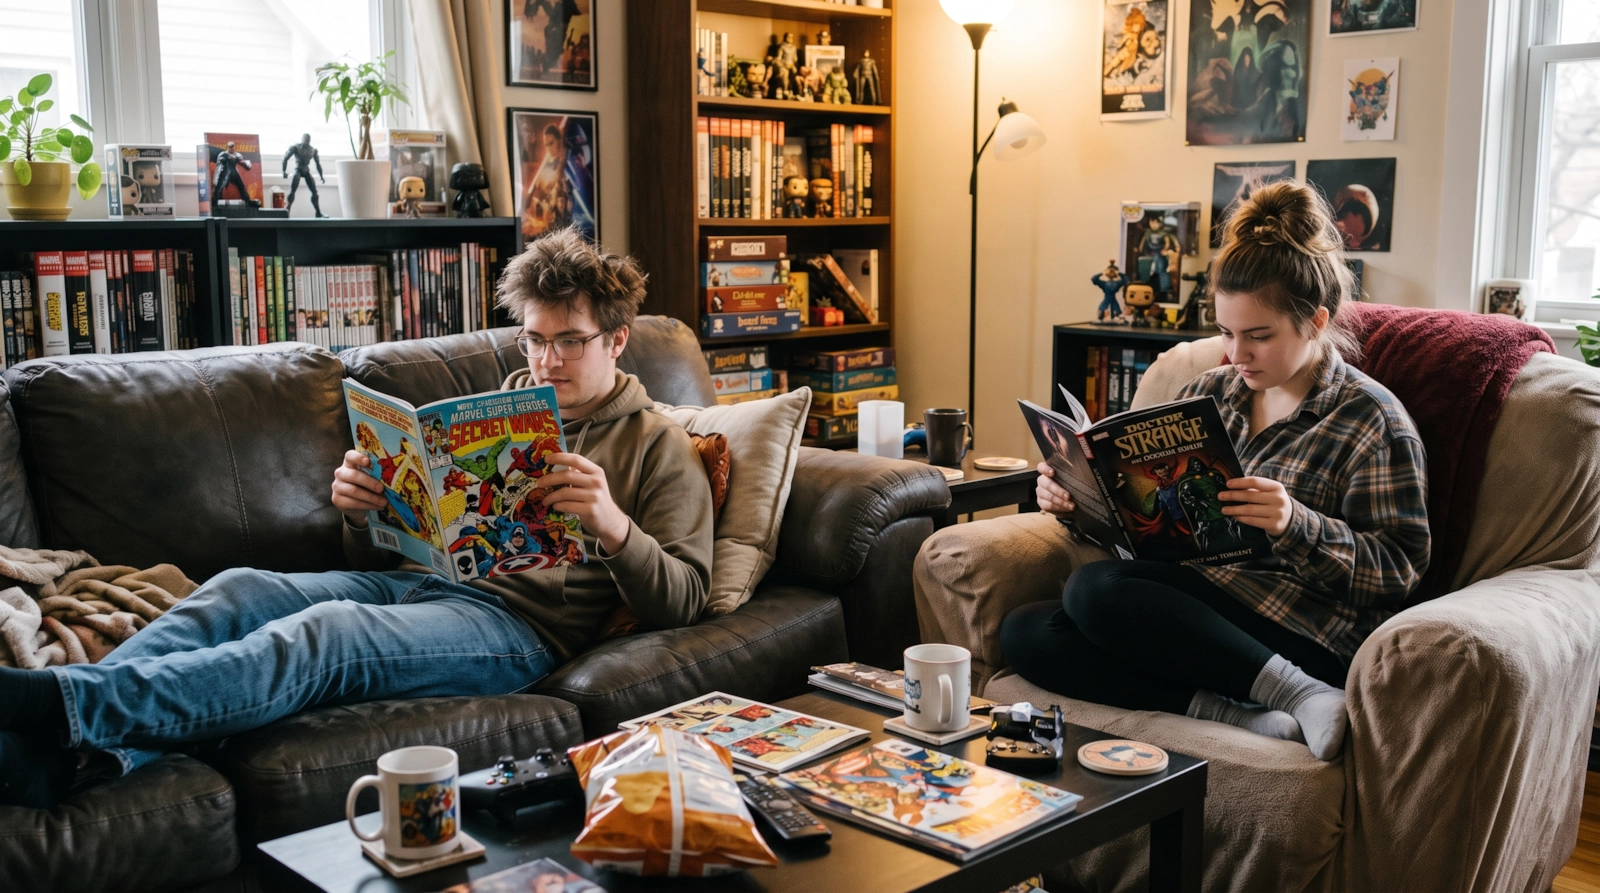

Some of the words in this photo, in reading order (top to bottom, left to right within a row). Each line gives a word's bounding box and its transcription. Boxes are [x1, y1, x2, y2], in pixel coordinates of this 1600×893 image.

[39, 255, 61, 265] MARVEL
[66, 256, 87, 265] MARVEL
[450, 408, 485, 424] MARVEL
[487, 404, 514, 417] SUPER
[516, 399, 549, 412] HEROES
[1124, 411, 1185, 434] DOCTOR
[449, 416, 507, 453] SECRET
[507, 409, 562, 435] WARS
[1114, 416, 1209, 460] STRANGE
